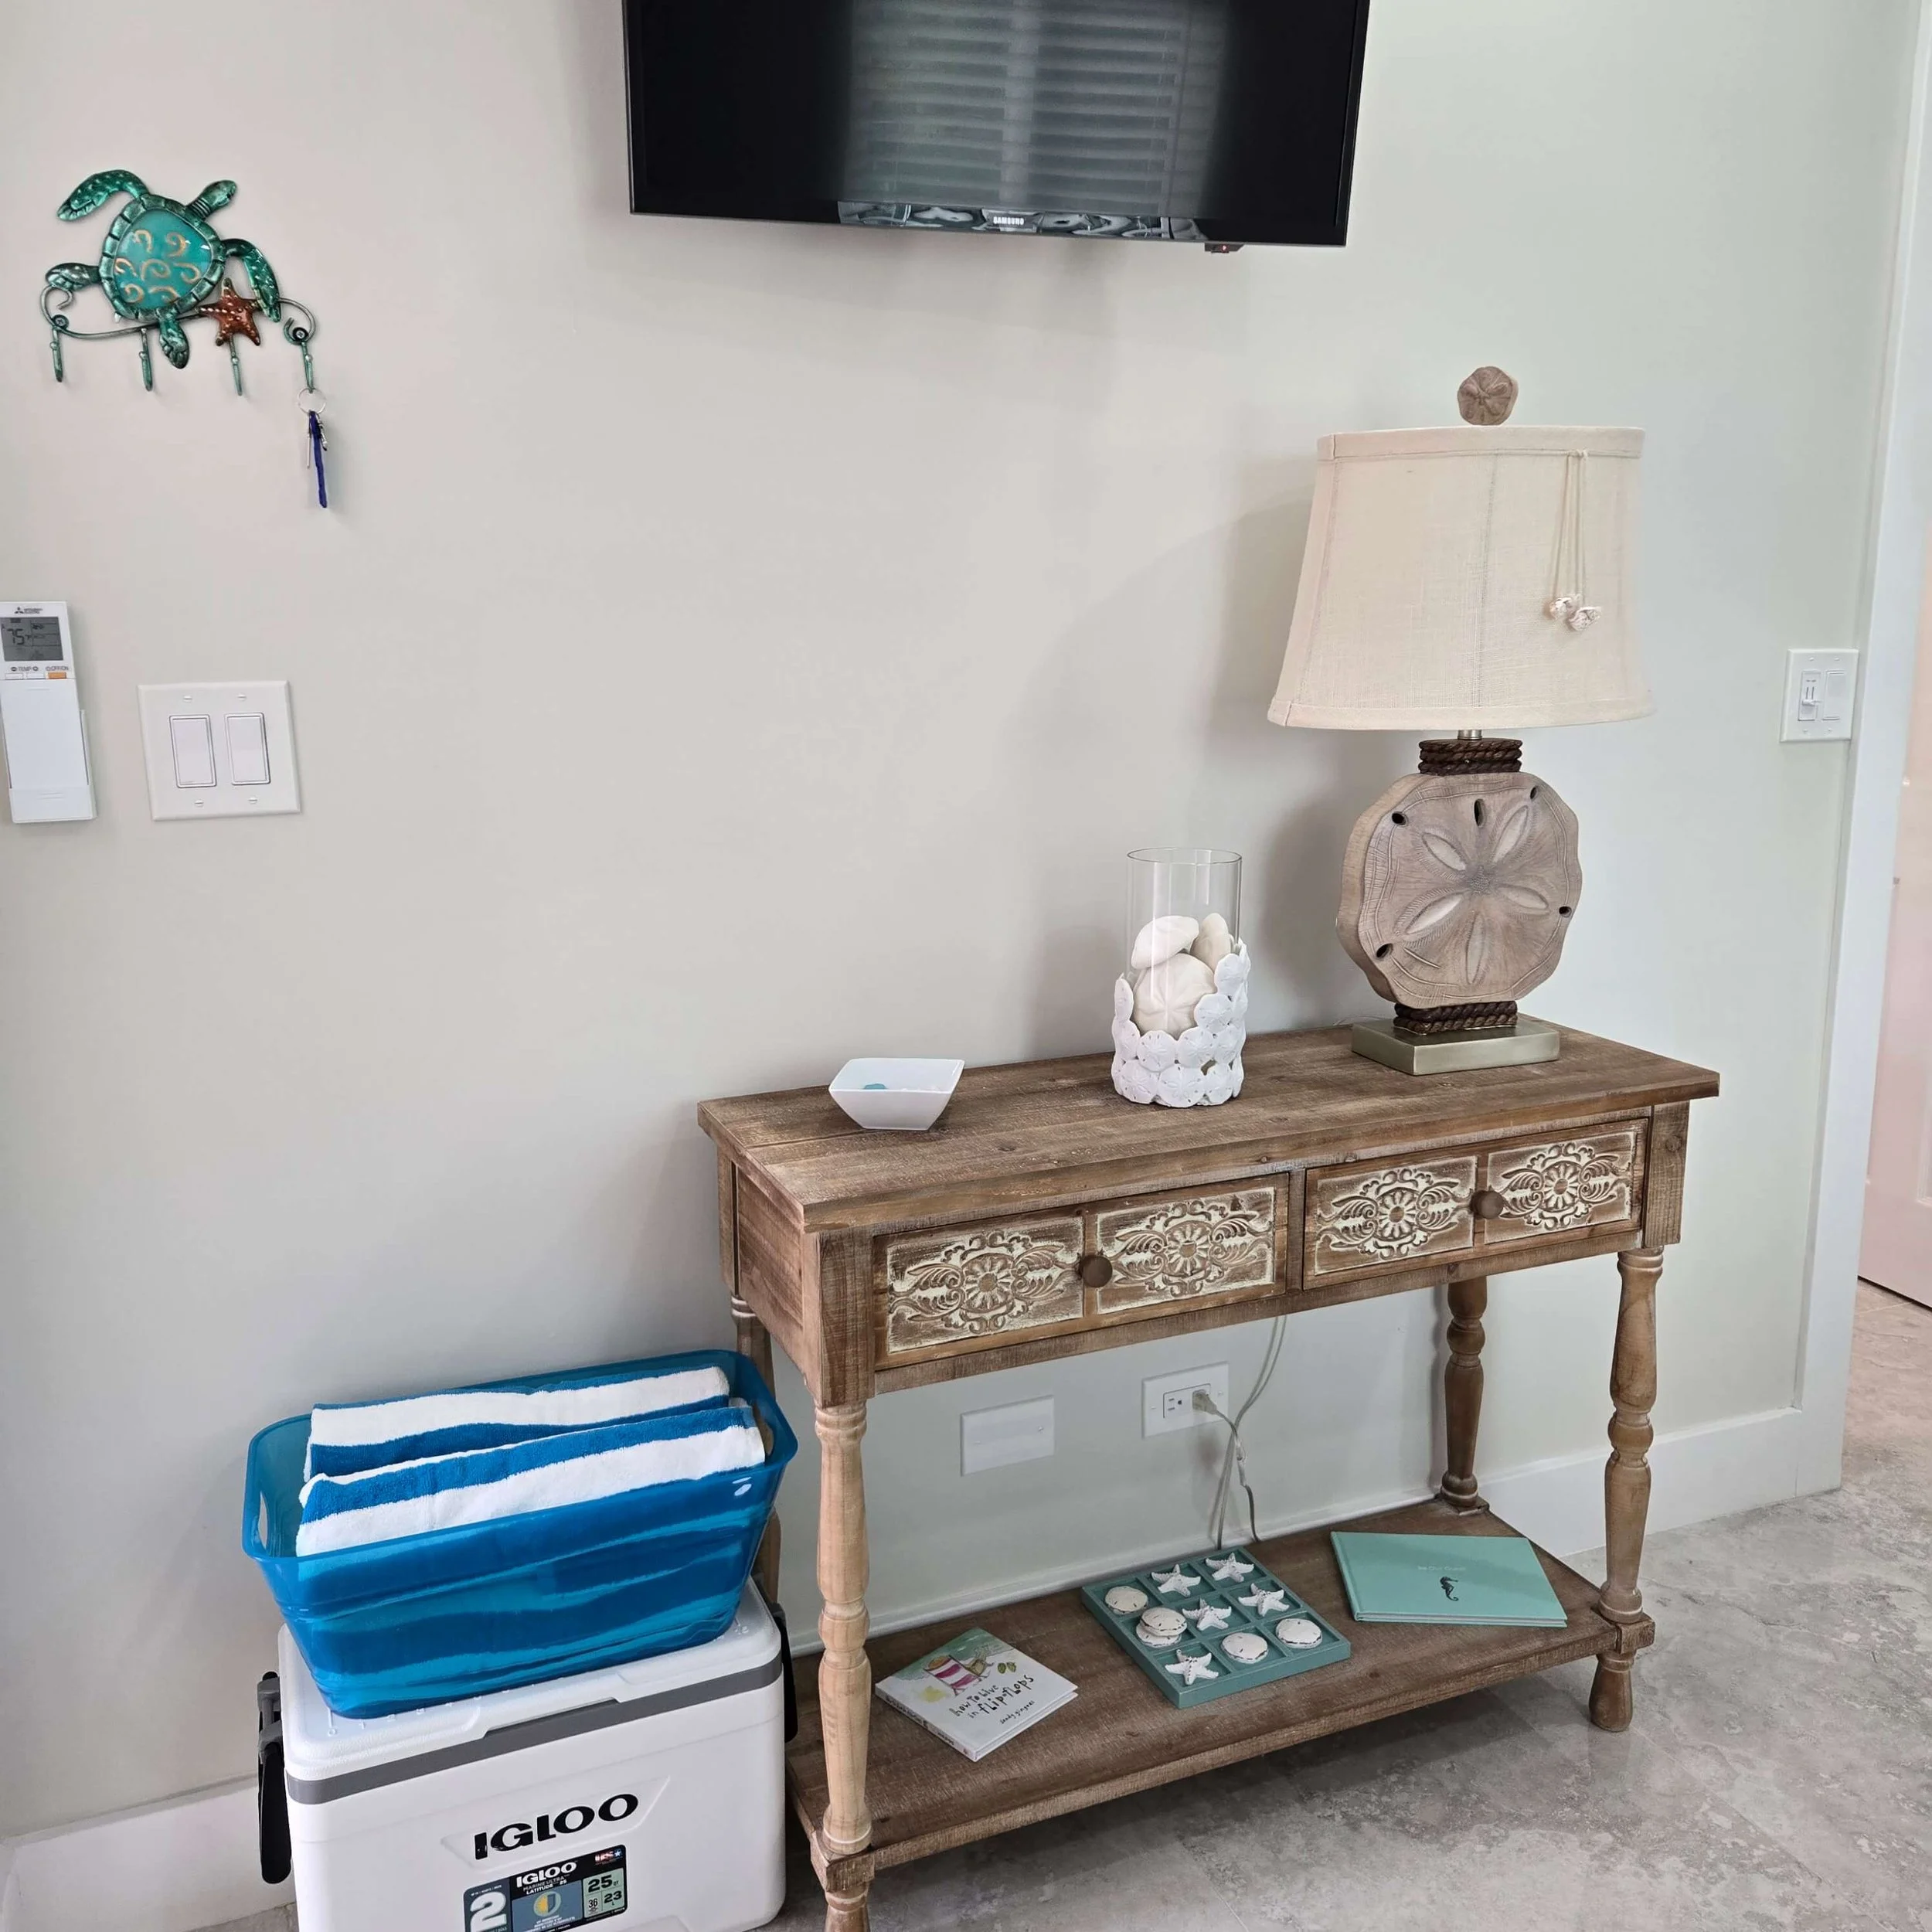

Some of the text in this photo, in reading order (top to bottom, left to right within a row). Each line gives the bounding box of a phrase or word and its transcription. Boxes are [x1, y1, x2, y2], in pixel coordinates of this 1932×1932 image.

[993, 216, 1025, 226] SAMSUNG
[949, 1702, 971, 1716] how
[968, 1709, 979, 1719] in
[474, 1793, 639, 1860] IGLOO
[516, 1862, 577, 1888] IGLOO
[526, 1883, 554, 1895] LATITUDE
[588, 1874, 613, 1893] 25
[588, 1898, 598, 1908] 36
[604, 1890, 622, 1903] 23
[470, 1891, 507, 1932] 2
